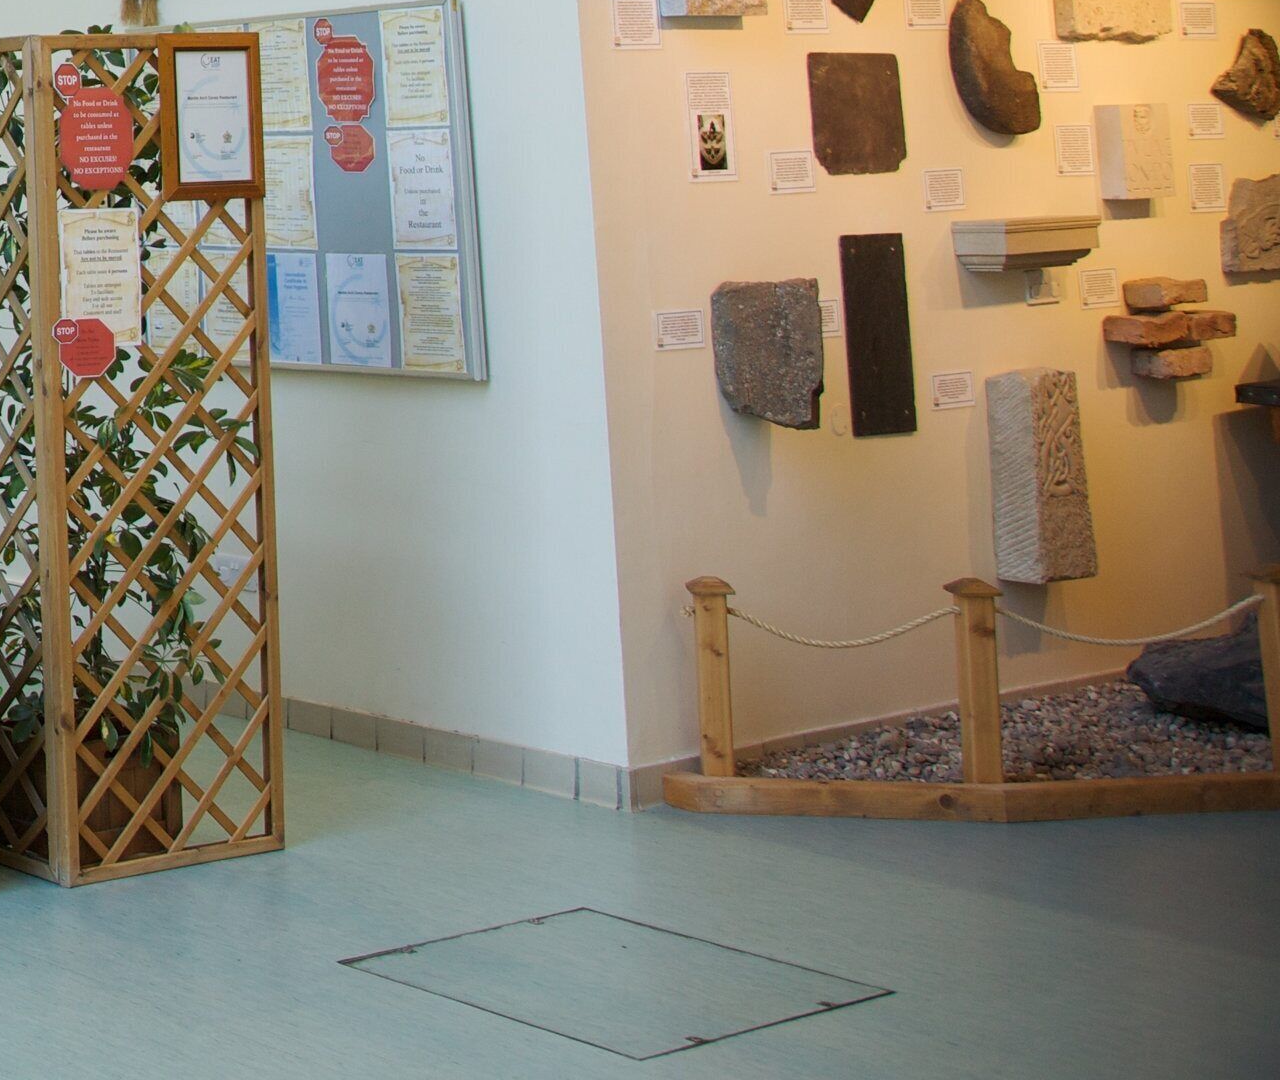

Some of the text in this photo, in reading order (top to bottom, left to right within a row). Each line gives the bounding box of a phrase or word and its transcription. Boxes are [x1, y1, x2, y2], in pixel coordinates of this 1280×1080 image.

[316, 28, 330, 36] STOP
[58, 75, 77, 85] STOP
[416, 154, 425, 162] No
[425, 165, 443, 173] Drink
